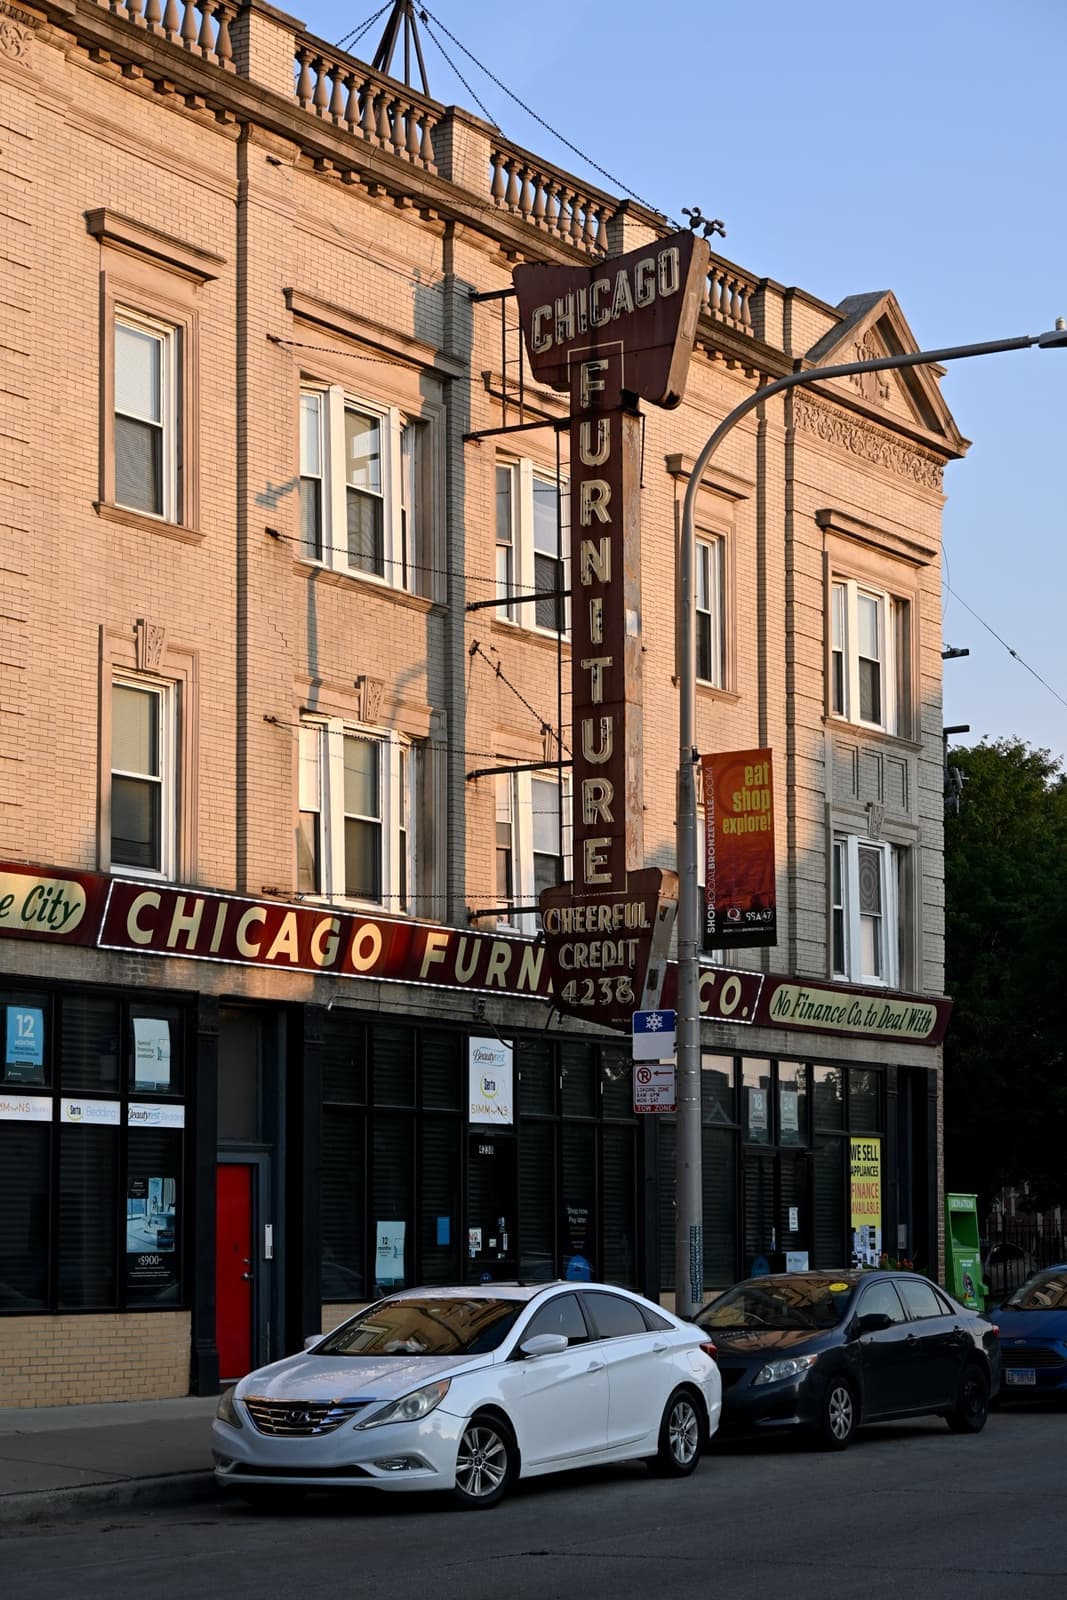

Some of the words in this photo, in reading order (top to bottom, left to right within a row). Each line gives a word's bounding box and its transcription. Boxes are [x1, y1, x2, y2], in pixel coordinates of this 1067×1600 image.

[531, 246, 680, 354] CHICAGO
[580, 359, 615, 884] FURNITURE
[744, 761, 769, 785] eat
[732, 787, 771, 813] shop
[722, 812, 771, 836] explore!
[21, 884, 81, 931] City
[543, 901, 650, 935] CHEERFUL
[126, 891, 383, 972] CHICAGO
[419, 931, 554, 994] FURN
[698, 971, 749, 1018] CO.
[558, 938, 640, 972] CREDIT
[561, 975, 635, 1007] 4238
[772, 989, 790, 1017] No
[793, 992, 845, 1024] Finance
[847, 1001, 862, 1026] Co.
[863, 1006, 876, 1028] to
[876, 1004, 903, 1031] Deal
[908, 1008, 934, 1034] With
[16, 1014, 35, 1038] 12
[70, 1105, 81, 1116] Serta
[850, 1144, 861, 1162] WE
[863, 1144, 879, 1162] SELL
[850, 1165, 879, 1177] APPLIANCES
[850, 1183, 879, 1199] FINANCE
[382, 1236, 389, 1245] 12
